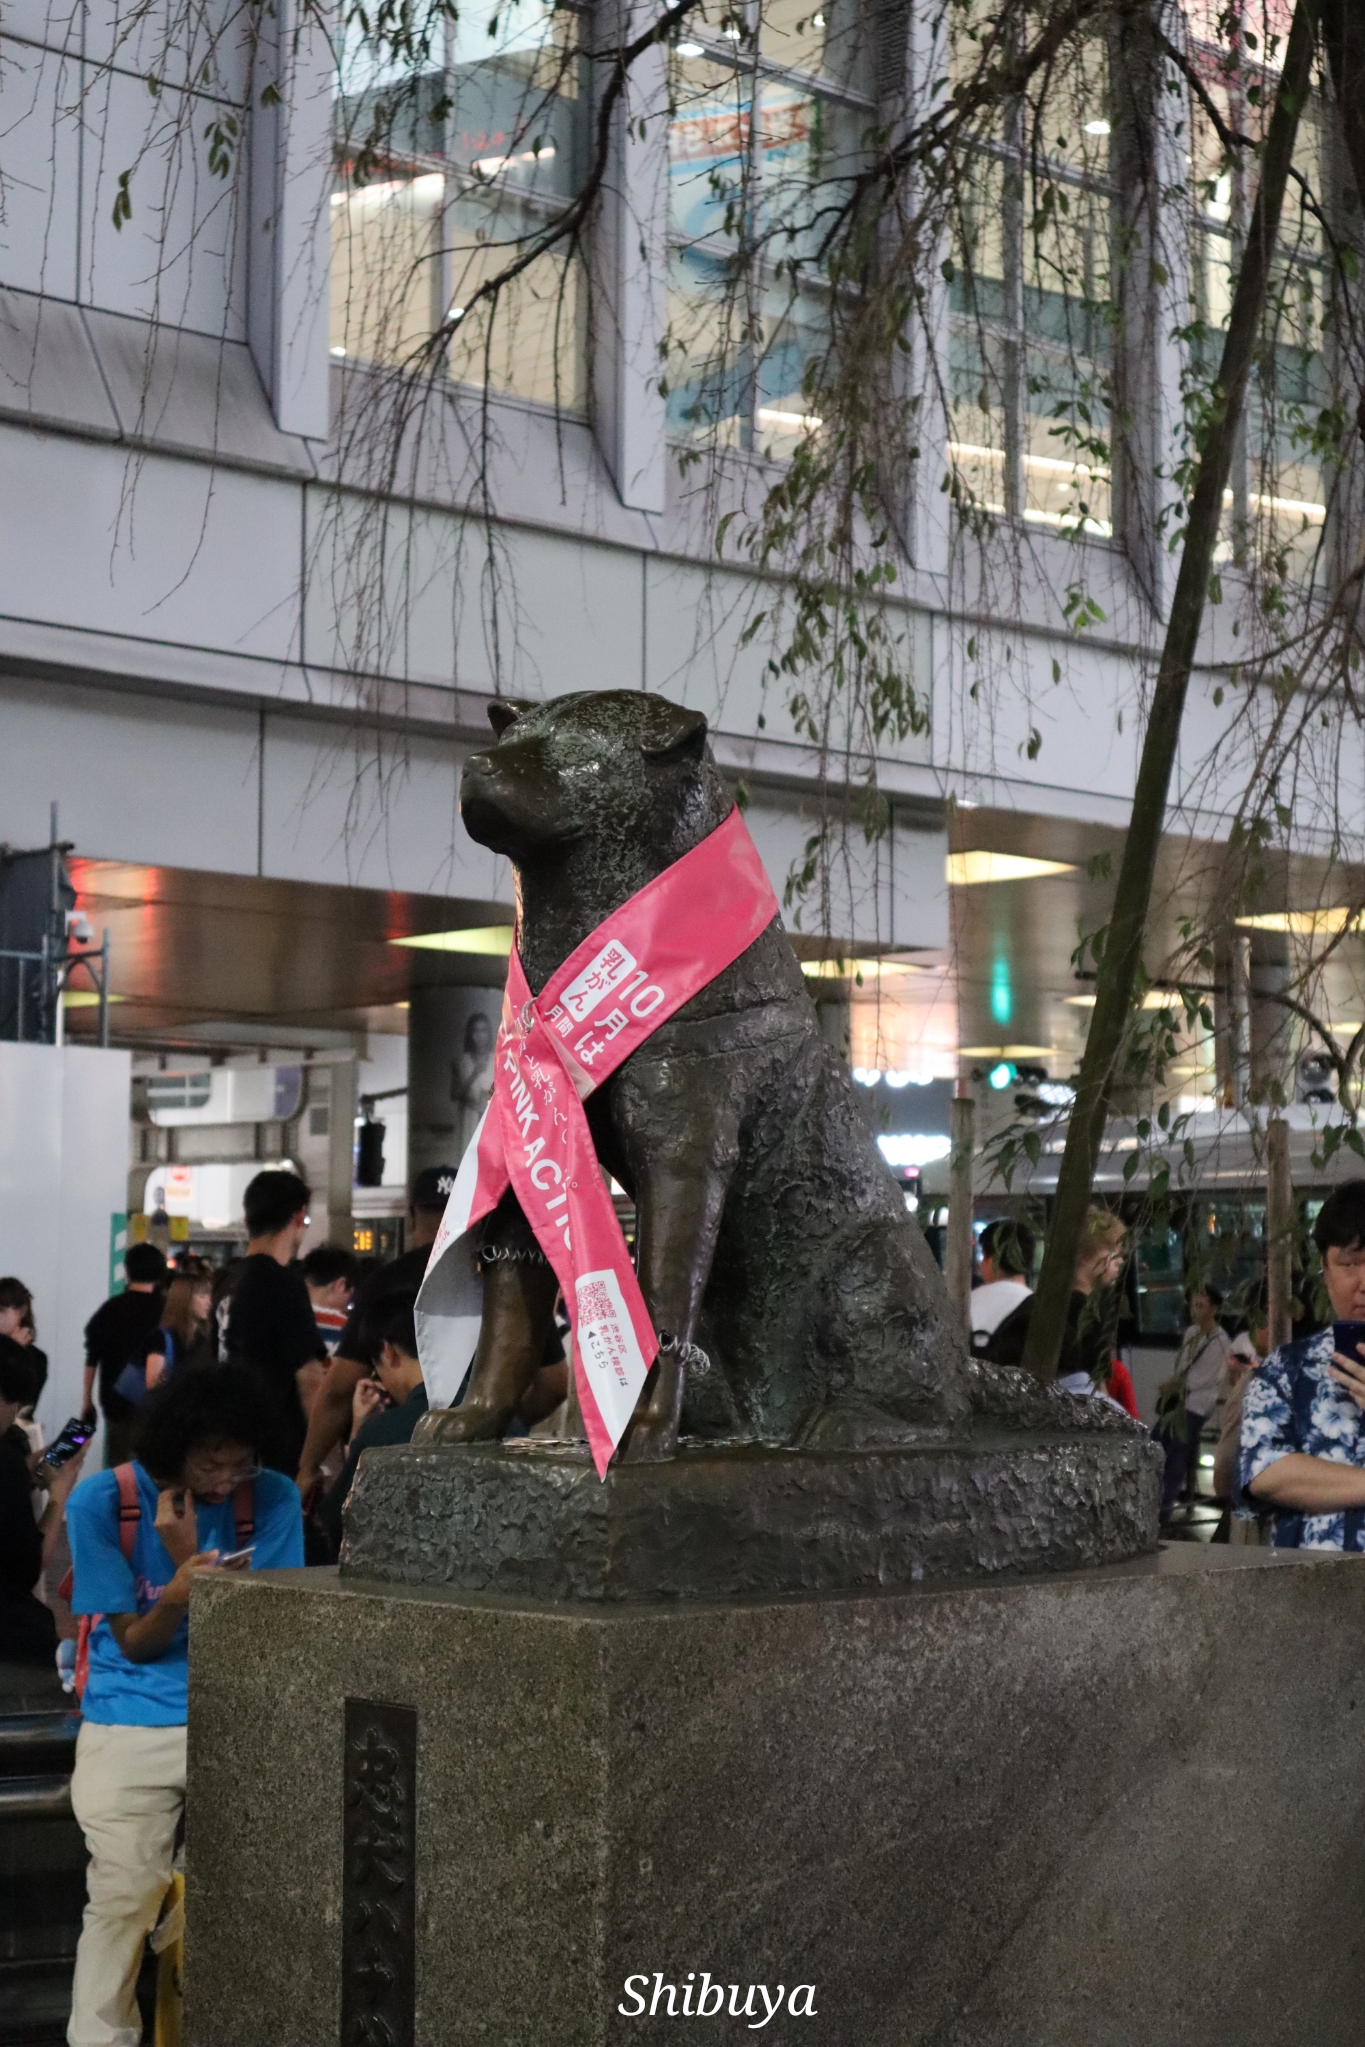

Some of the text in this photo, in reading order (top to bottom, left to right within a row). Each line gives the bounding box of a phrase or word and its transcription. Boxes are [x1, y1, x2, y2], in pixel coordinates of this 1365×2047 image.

[574, 969, 665, 1065] 10月は
[503, 1047, 572, 1251] PINK ACTI
[590, 1340, 609, 1369] こちら
[609, 1323, 628, 1354] 渋谷区
